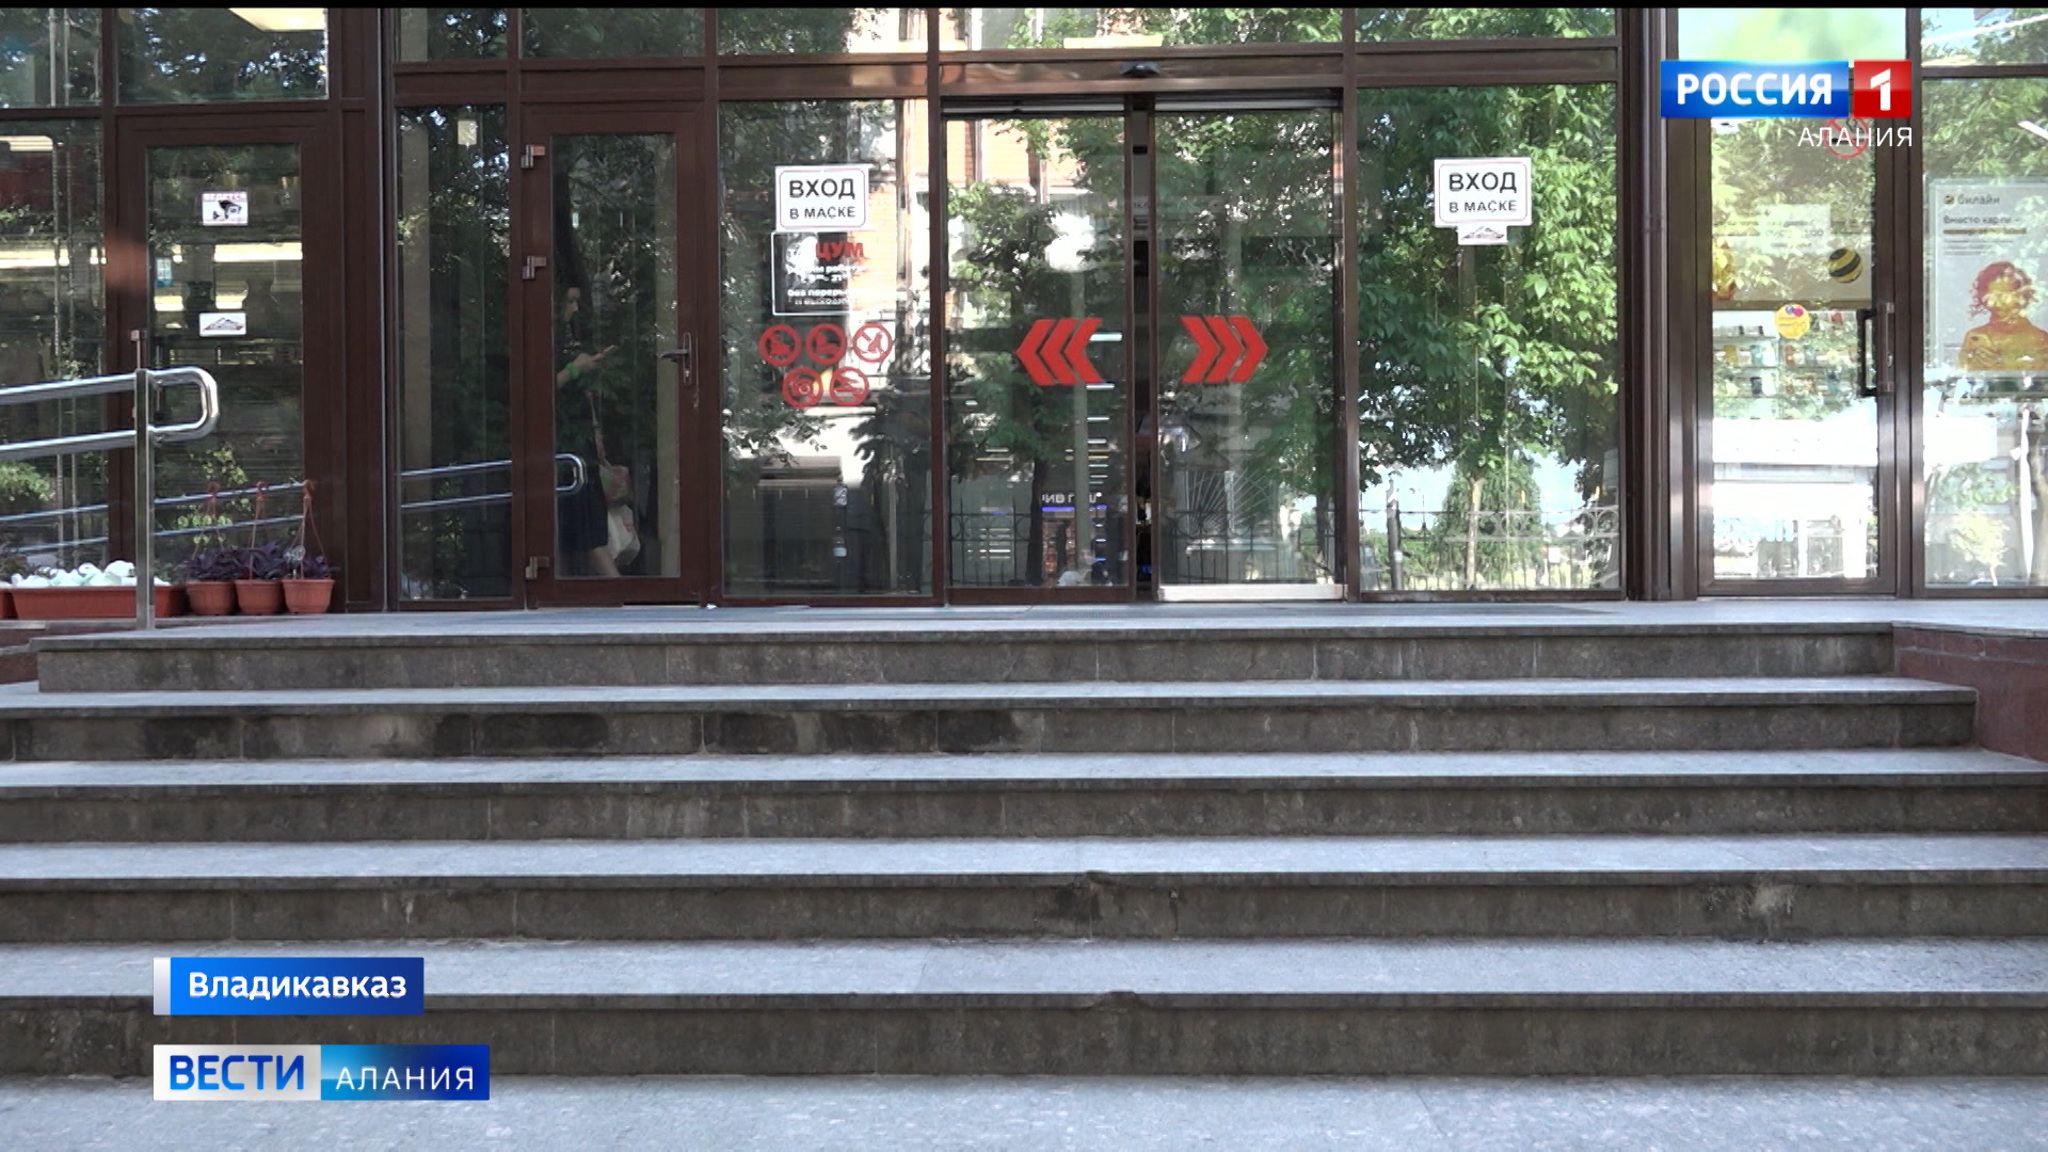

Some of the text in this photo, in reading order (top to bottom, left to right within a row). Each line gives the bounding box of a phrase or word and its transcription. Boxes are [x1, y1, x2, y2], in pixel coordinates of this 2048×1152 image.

[789, 178, 856, 200] ВХОД
[1449, 171, 1517, 194] ВХОД
[789, 206, 856, 220] В МАСКЕ
[1449, 200, 1517, 213] В МАСКЕ
[815, 241, 865, 261] ЦУМ
